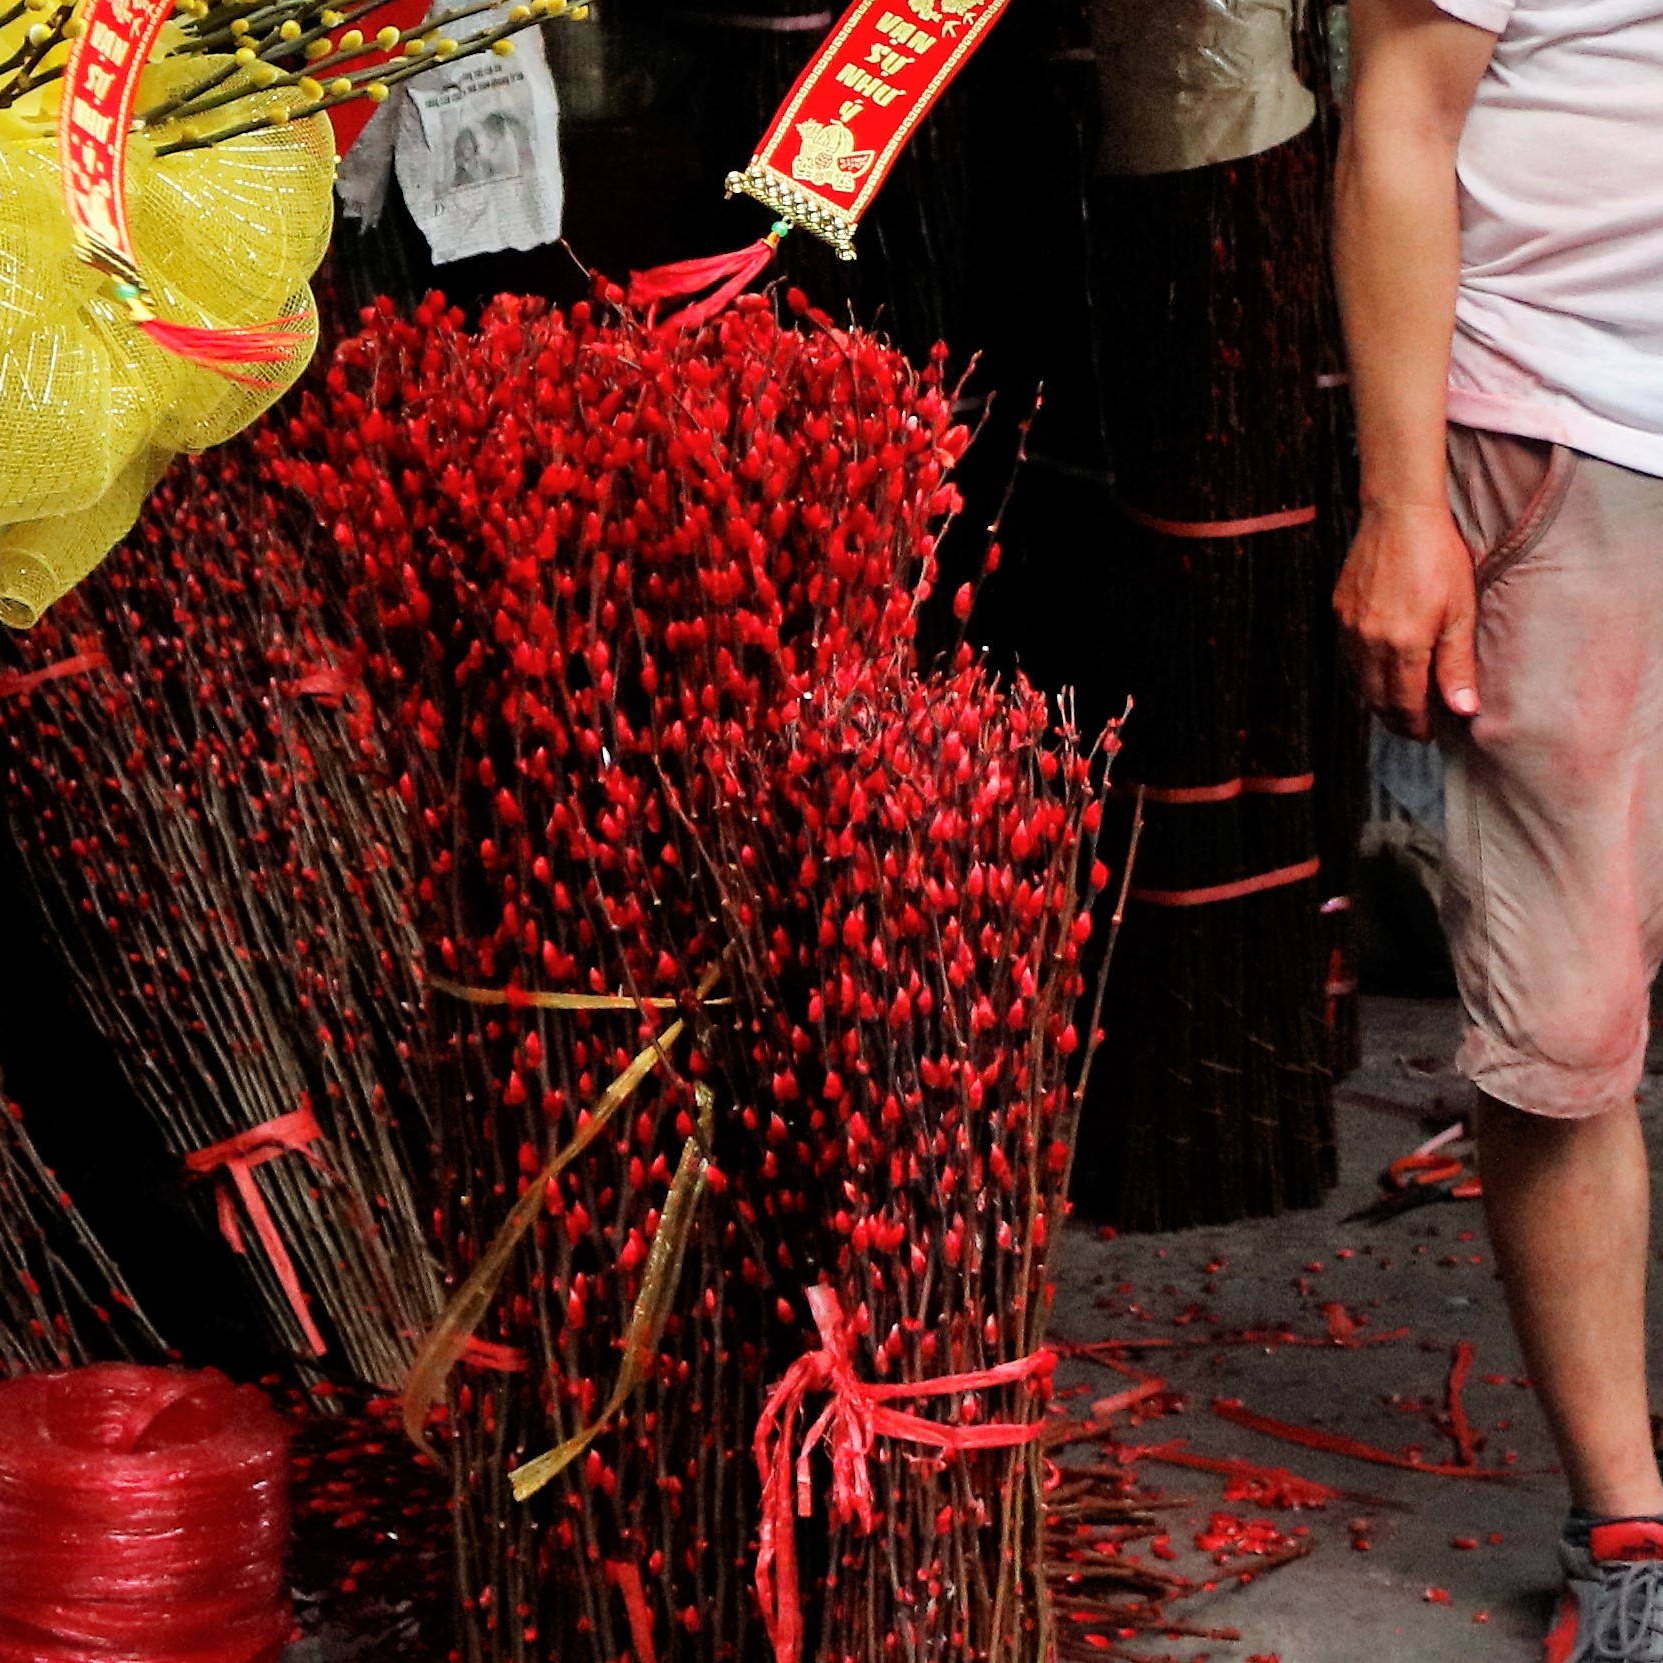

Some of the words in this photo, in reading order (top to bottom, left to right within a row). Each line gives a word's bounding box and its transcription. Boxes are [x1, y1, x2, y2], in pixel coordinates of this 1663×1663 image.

[875, 11, 937, 55] VẠN
[864, 43, 915, 77] SỰ
[835, 62, 906, 107] NHƯ
[839, 99, 864, 123] Ý
